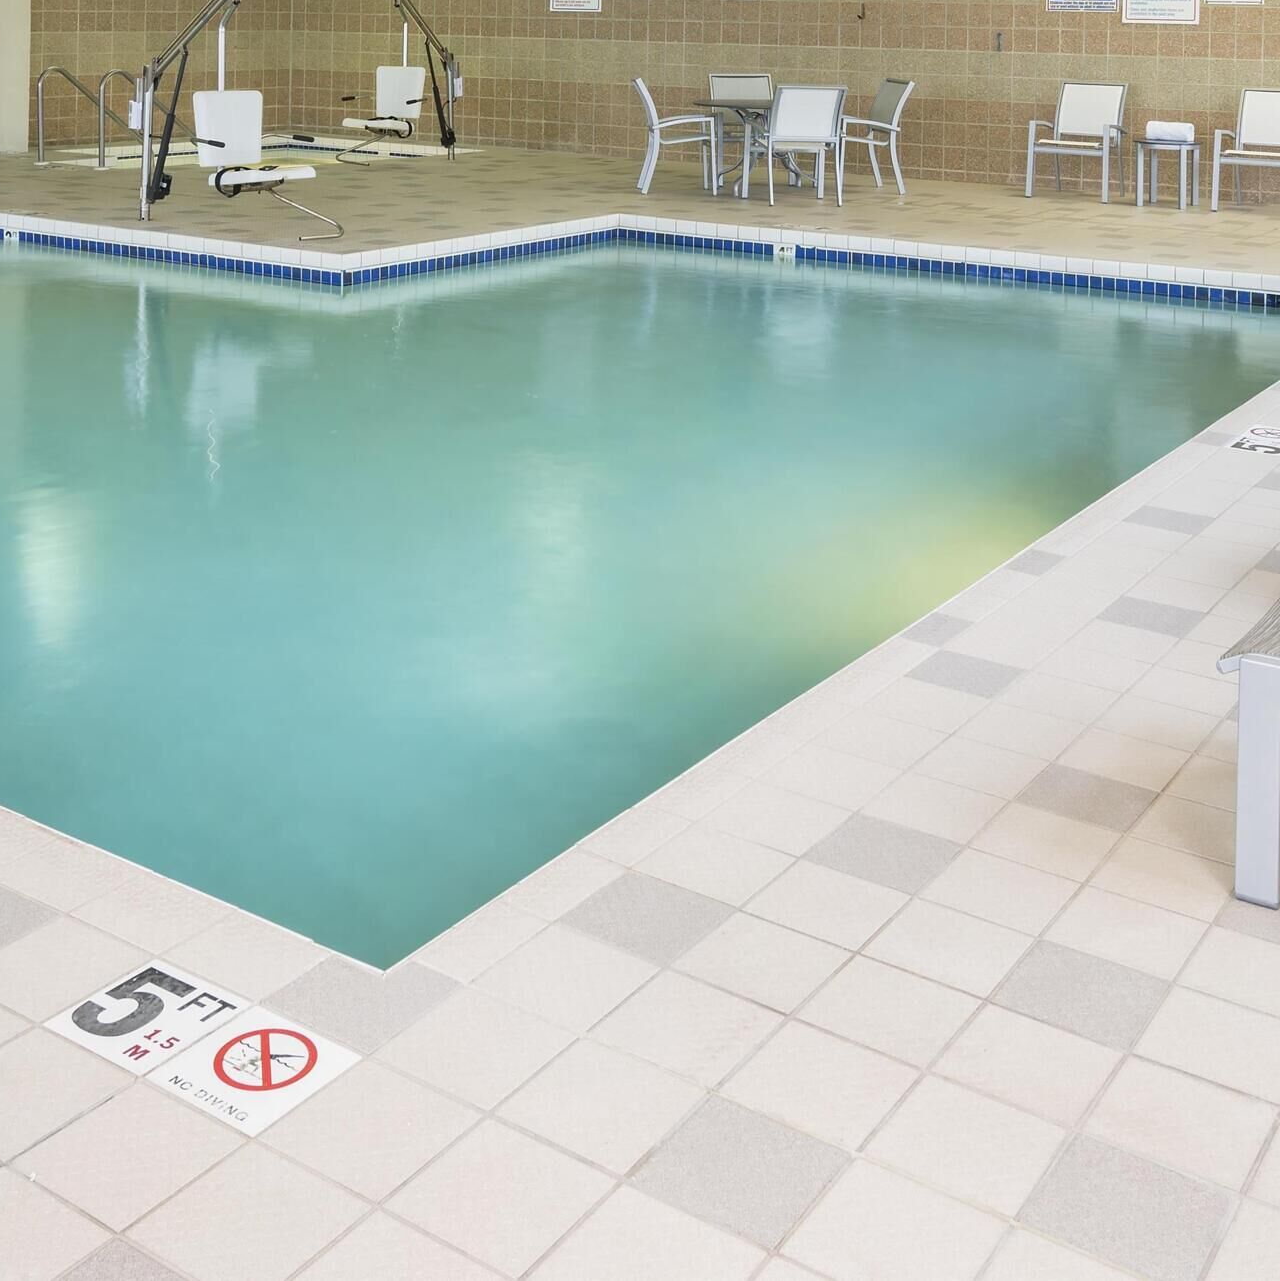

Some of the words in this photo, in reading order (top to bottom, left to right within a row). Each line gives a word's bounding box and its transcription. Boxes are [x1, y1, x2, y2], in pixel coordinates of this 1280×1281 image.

[71, 966, 197, 1037] 5
[176, 991, 238, 1023] FT
[143, 1029, 181, 1049] 1.5
[122, 1044, 150, 1061] M
